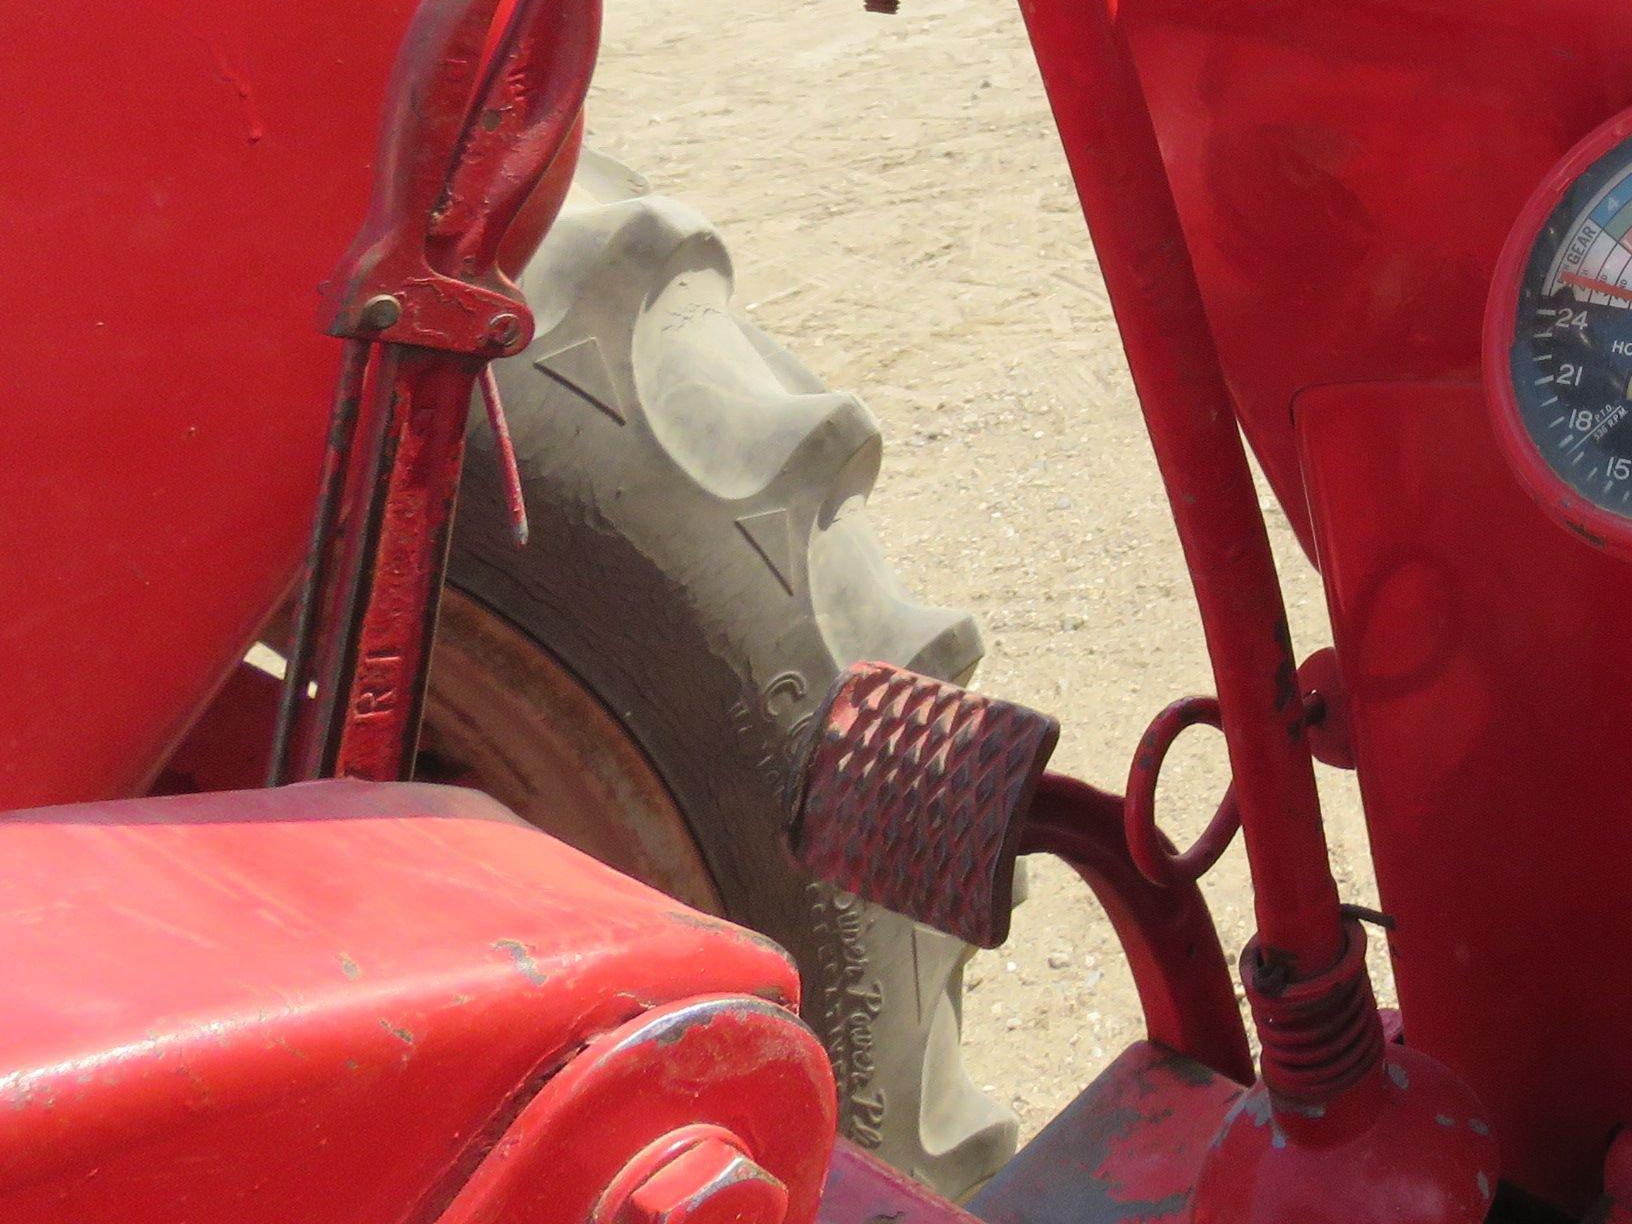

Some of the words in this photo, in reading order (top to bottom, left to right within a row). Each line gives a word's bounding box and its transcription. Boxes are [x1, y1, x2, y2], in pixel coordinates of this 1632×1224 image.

[1607, 197, 1620, 212] 4
[1567, 226, 1597, 265] GEAR
[1555, 307, 1588, 330] 24
[1556, 363, 1583, 386] 21
[1568, 408, 1594, 432] 18
[1606, 456, 1632, 480] 15
[849, 1088, 887, 1150] Pl
